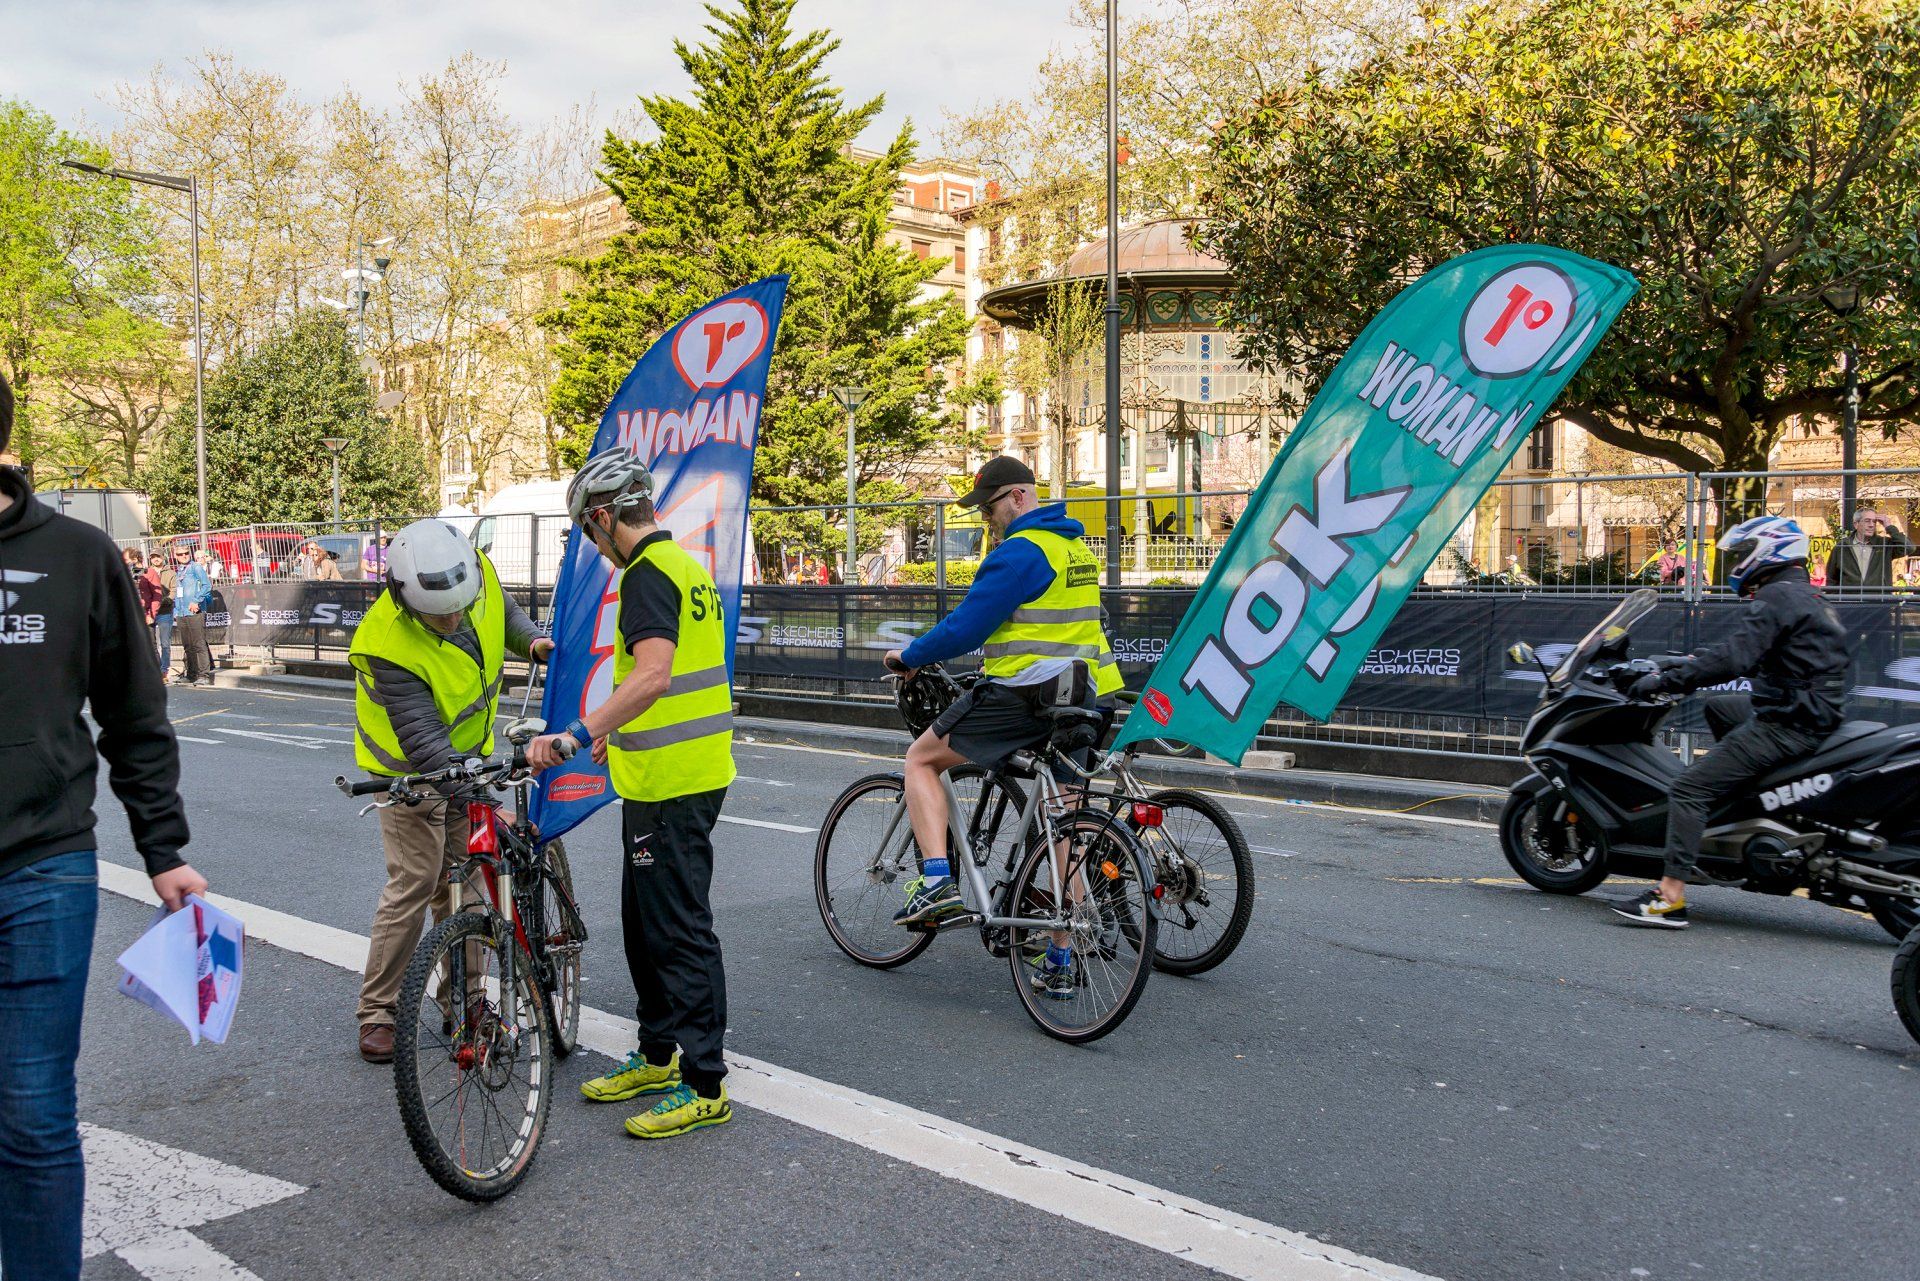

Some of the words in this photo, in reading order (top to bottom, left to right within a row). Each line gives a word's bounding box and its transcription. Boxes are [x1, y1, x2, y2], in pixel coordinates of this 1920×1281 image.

[1356, 340, 1501, 469] WOMAN
[617, 391, 759, 467] WOMAN
[1813, 540, 1831, 552] DYA
[1178, 438, 1414, 723] 10K
[261, 610, 299, 619] SKECHERS
[770, 637, 844, 648] PERFORMANCE
[771, 625, 844, 639] SKECHERS
[1758, 773, 1834, 812] DEMO
